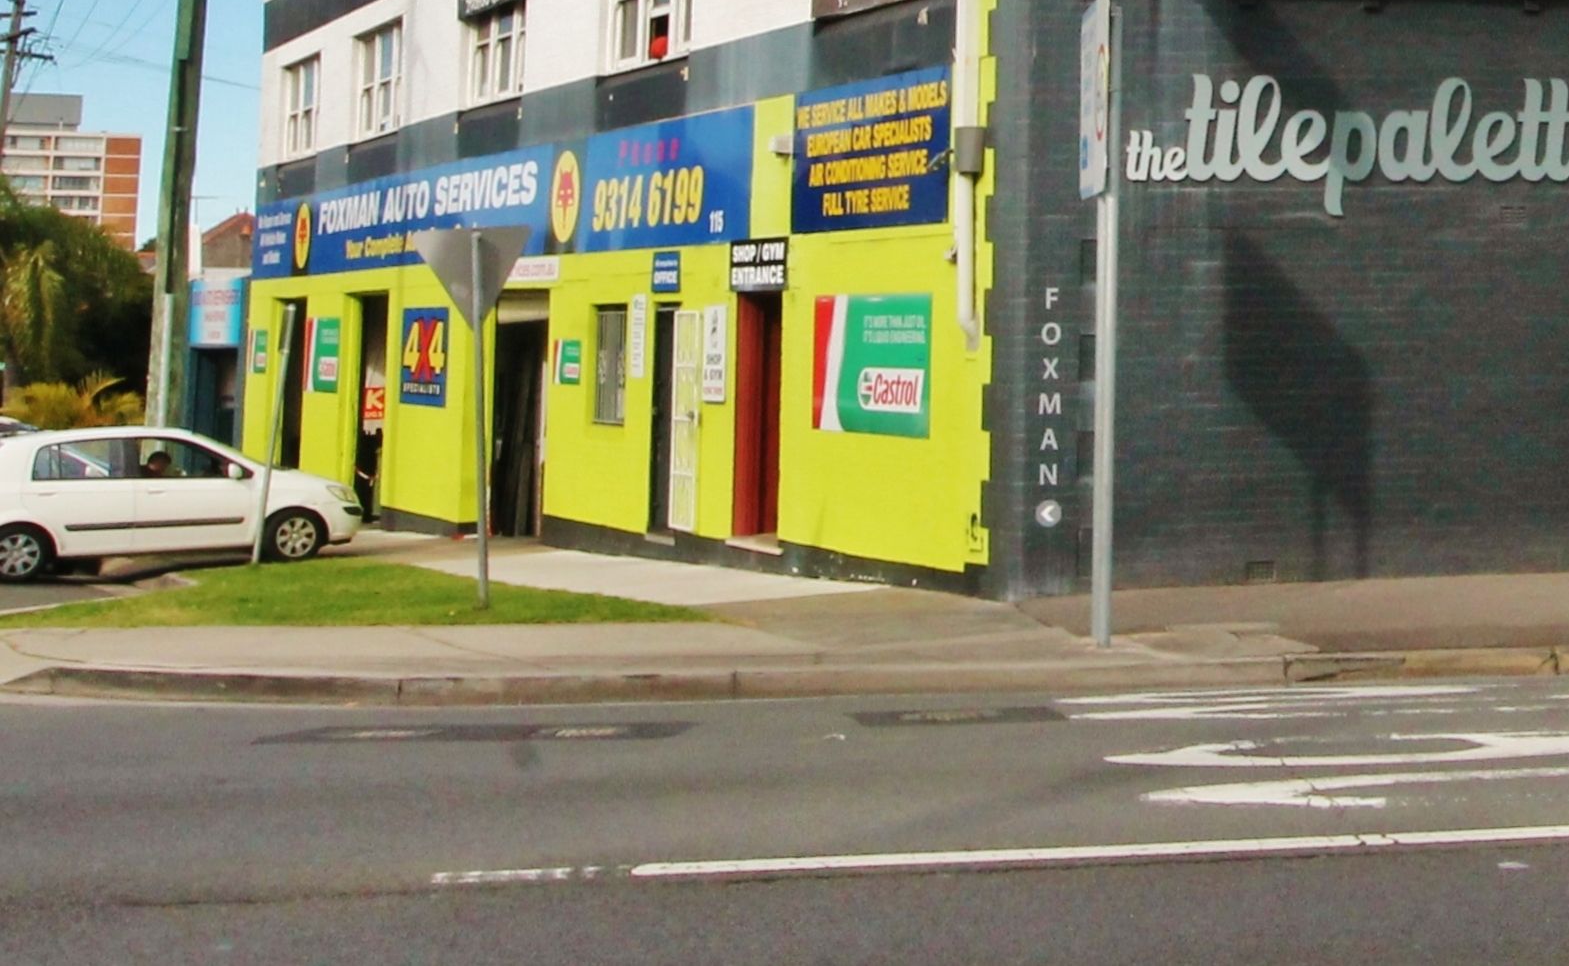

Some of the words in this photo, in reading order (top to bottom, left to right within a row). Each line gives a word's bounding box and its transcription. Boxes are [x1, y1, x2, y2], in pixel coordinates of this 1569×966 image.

[811, 99, 847, 127] SERVICE
[847, 95, 865, 121] ALL
[865, 89, 897, 117] MAKES
[907, 80, 948, 111] MODELS
[807, 128, 852, 158] EUROPEAN
[853, 126, 872, 151] CAR
[873, 115, 933, 149] SPECIALISTS
[825, 155, 886, 185] CONDITIONING
[887, 148, 929, 178] SERVICE
[318, 190, 381, 235] FOXMAN
[383, 180, 430, 224] AUTO
[434, 160, 538, 217] SERVICES
[592, 174, 644, 233] 9314
[647, 165, 704, 227] 6199
[822, 192, 844, 217] FULL
[845, 188, 870, 215] TYRE
[870, 184, 911, 212] SERVICE
[732, 244, 756, 263] SHOP
[762, 242, 786, 261] GYM
[731, 264, 784, 285] ENTRANCE
[873, 372, 919, 406] Castrol
[1038, 287, 1063, 486] FOXMAN
